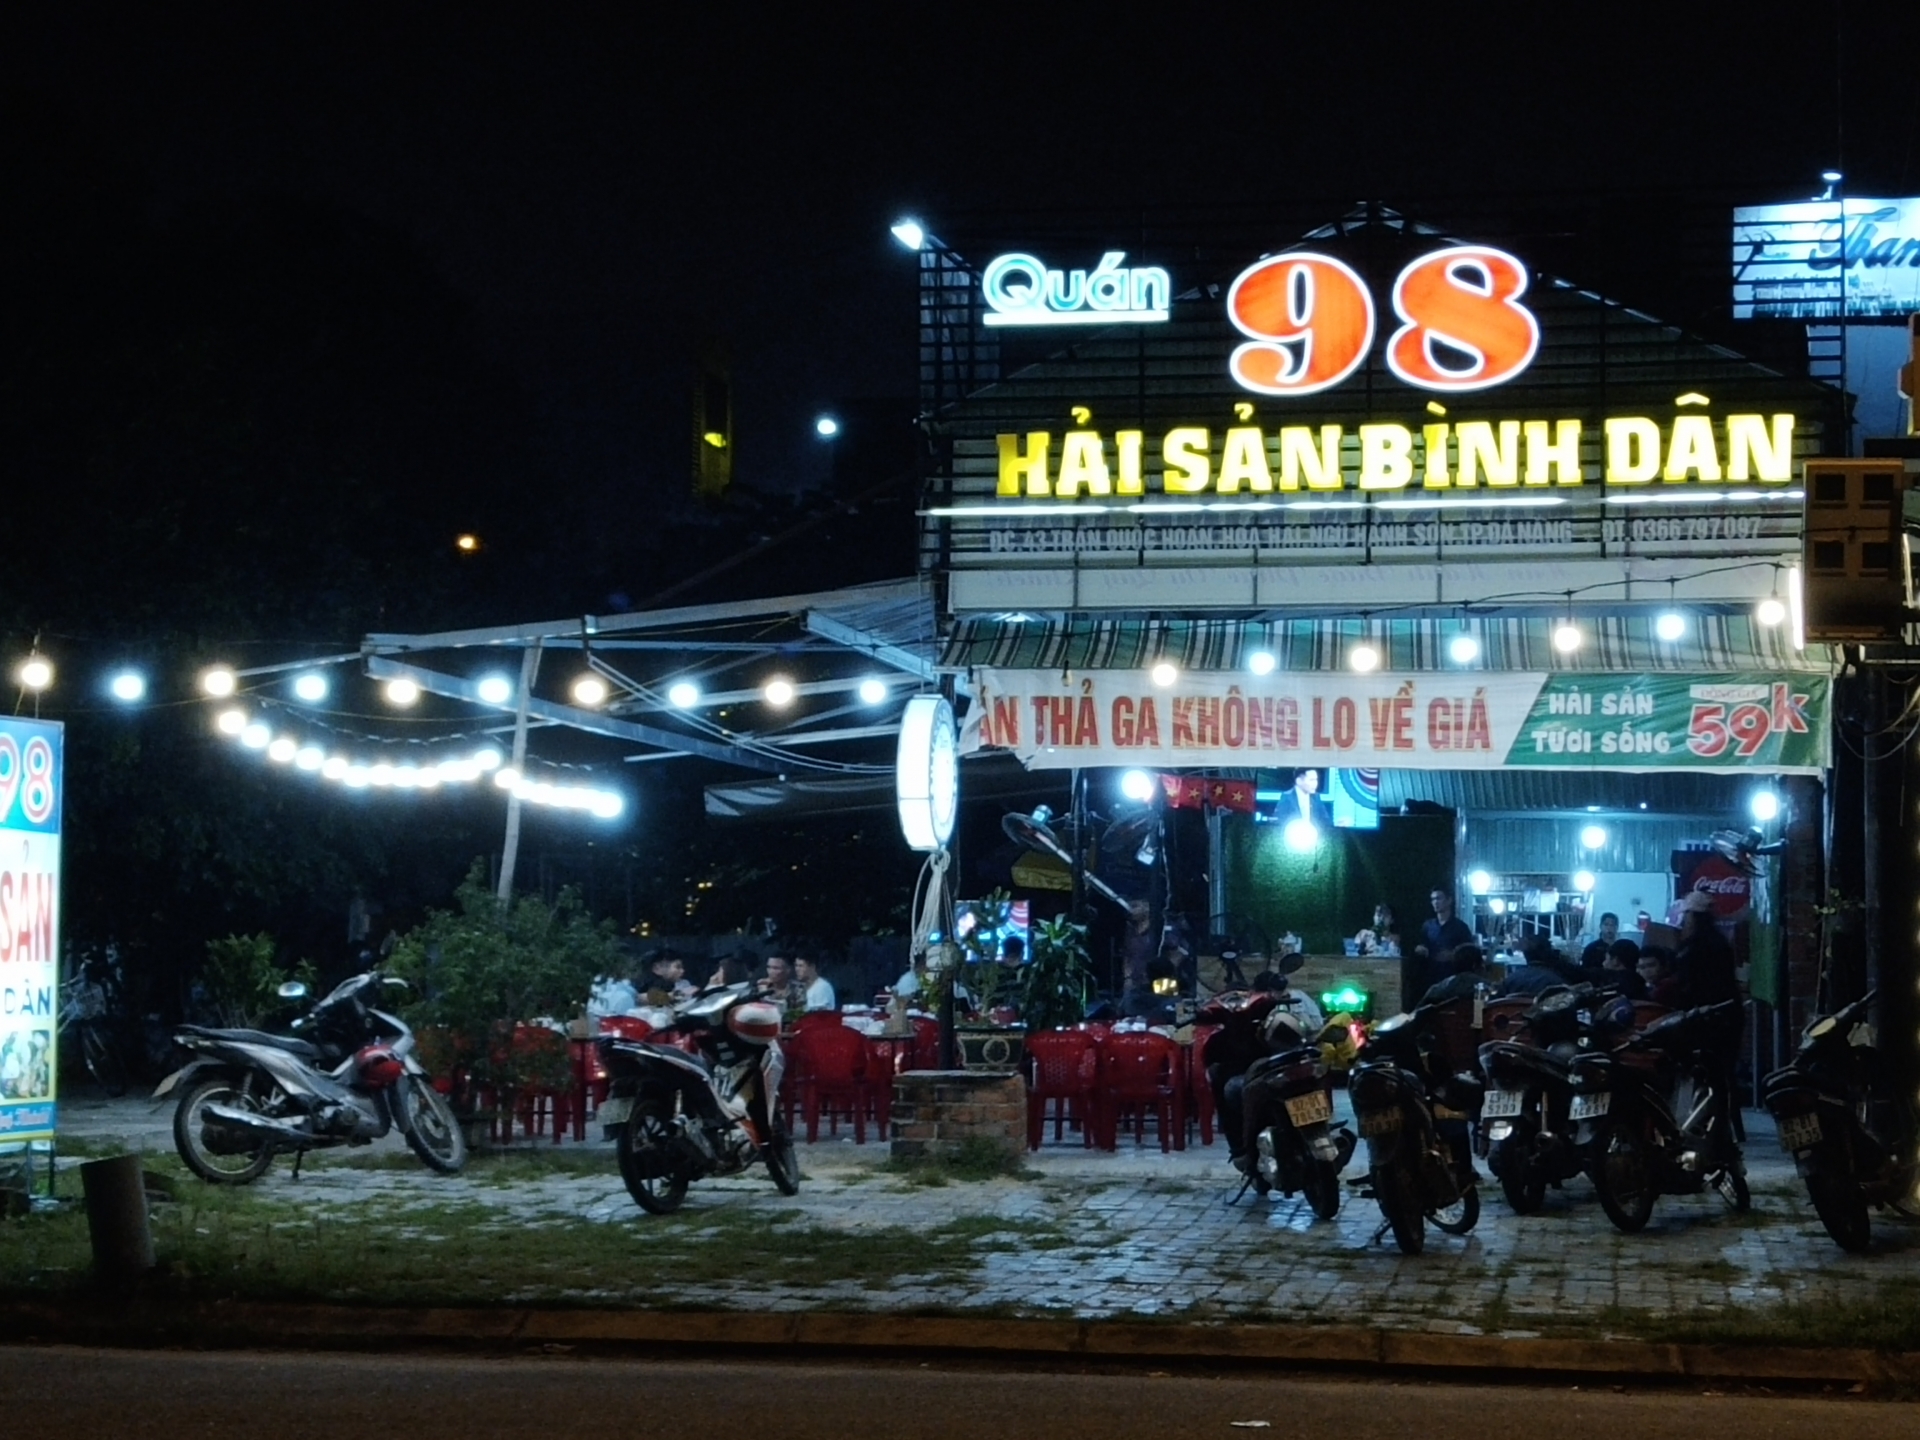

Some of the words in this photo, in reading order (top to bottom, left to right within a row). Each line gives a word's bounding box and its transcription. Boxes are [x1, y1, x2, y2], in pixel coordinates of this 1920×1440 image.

[982, 251, 1170, 315] Quán
[1226, 246, 1541, 397] 98
[996, 406, 1144, 498] HẢI
[1162, 402, 1345, 495] SẢN
[1357, 401, 1582, 490] BÌNH
[1604, 392, 1796, 485] DÂN
[1031, 678, 1099, 746] THẢ
[1112, 696, 1159, 747] GA
[1172, 685, 1298, 749] KHÔNG
[1313, 697, 1357, 748] LO
[1369, 680, 1415, 749] VỀ
[1427, 686, 1491, 749] GIÁ
[1531, 725, 1591, 753] TƯƠI
[1601, 721, 1670, 753] SỐNG
[1549, 686, 1591, 715] HẢI
[1601, 686, 1654, 716] SẢN
[0, 731, 54, 824] 98
[0, 839, 52, 963] SẢN
